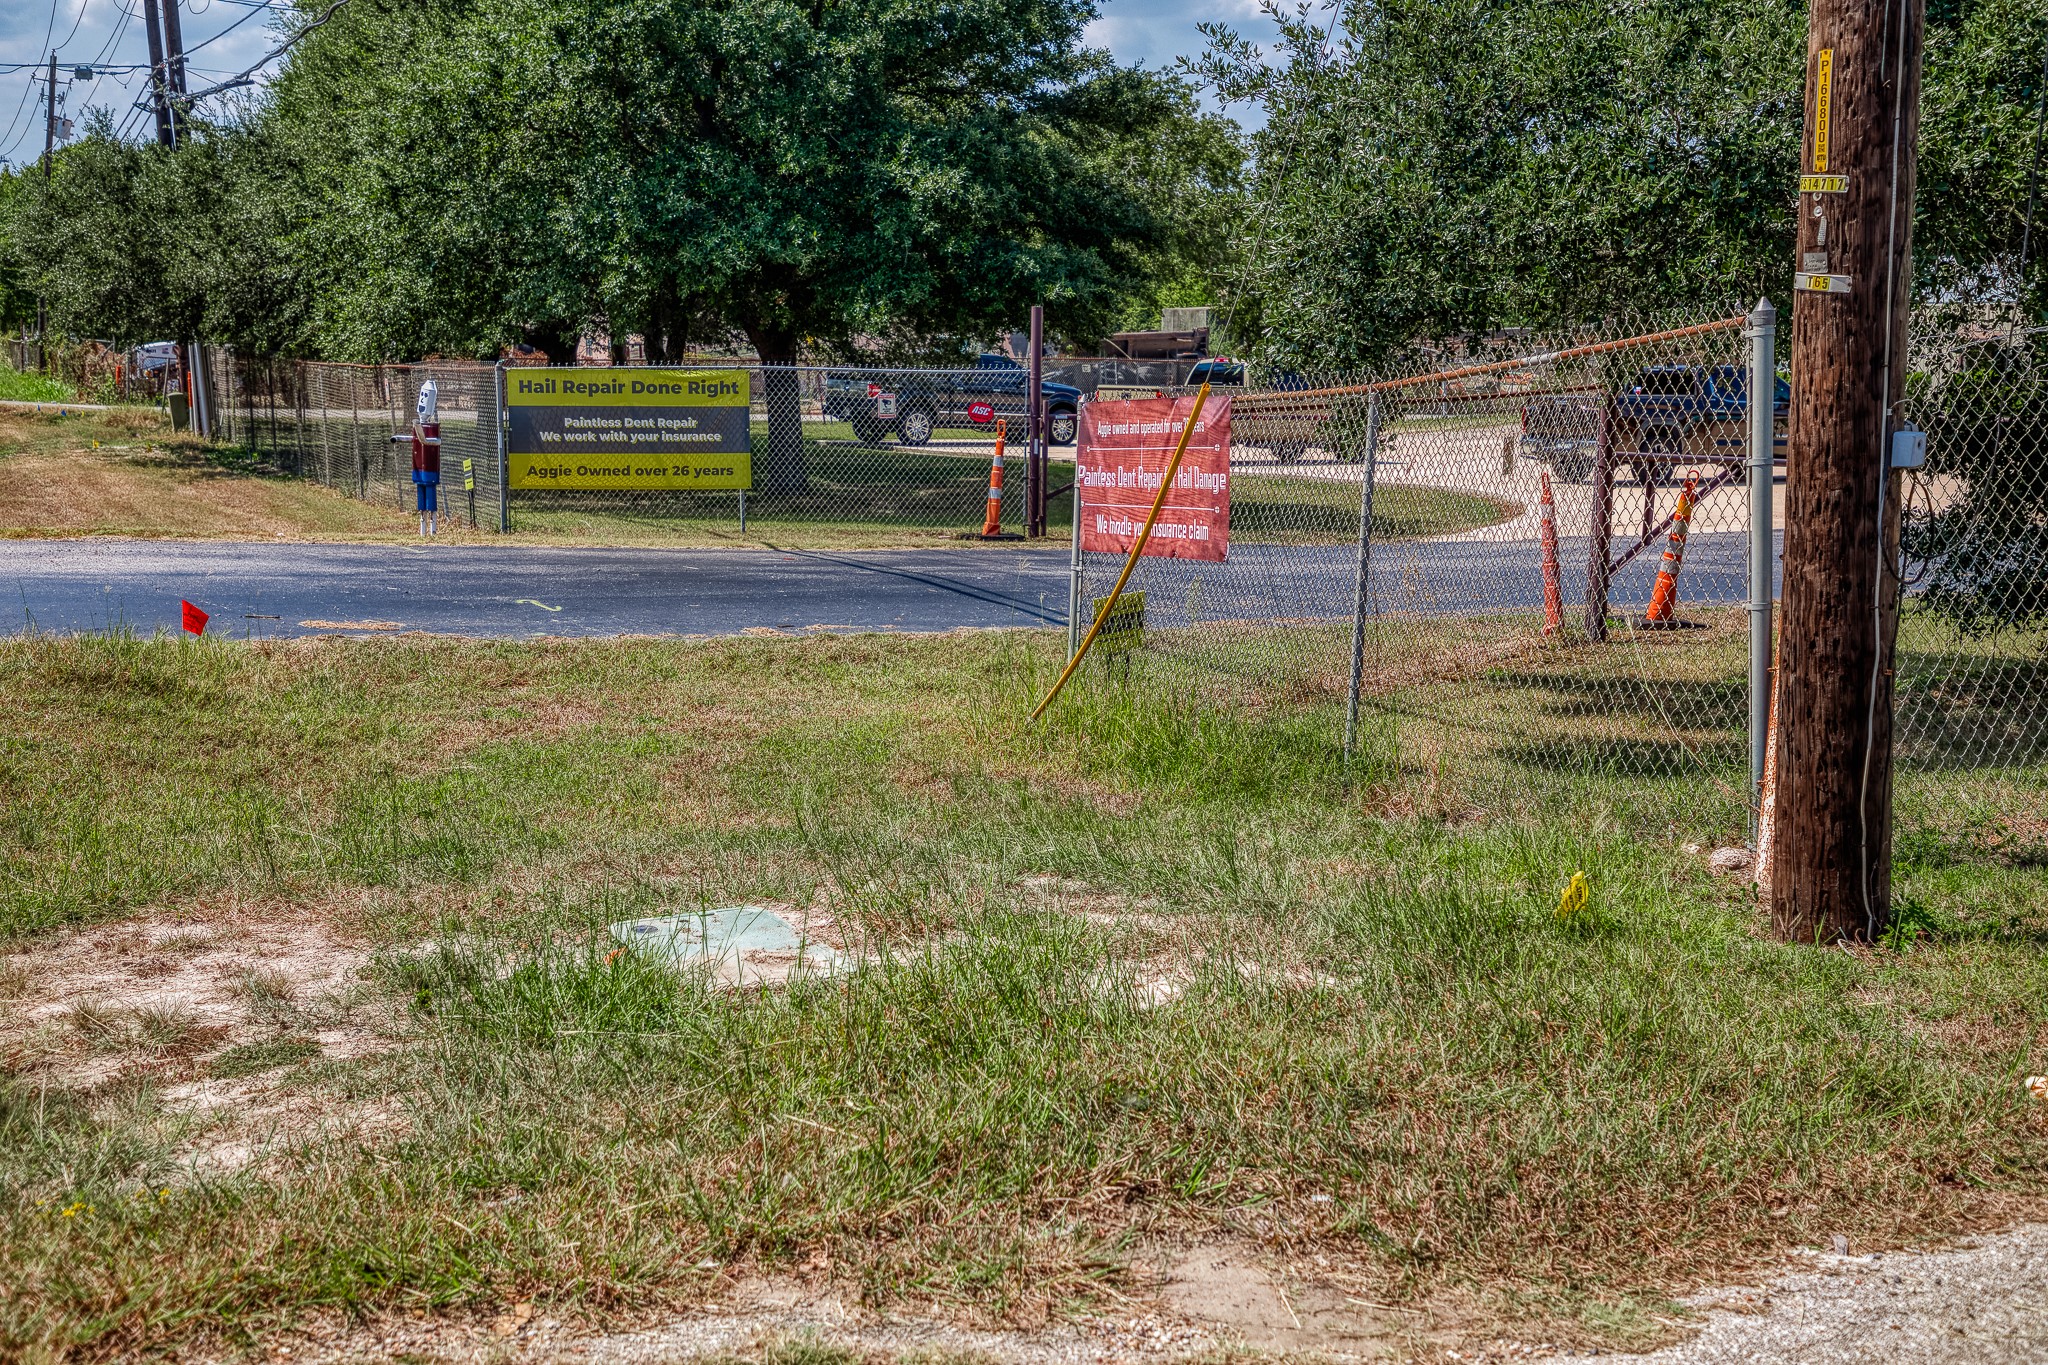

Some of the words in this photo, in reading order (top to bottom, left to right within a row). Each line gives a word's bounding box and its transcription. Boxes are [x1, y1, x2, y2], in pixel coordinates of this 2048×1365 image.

[1818, 60, 1829, 143] P166800
[519, 378, 557, 394] Hail
[563, 379, 625, 397] Repair
[632, 380, 682, 395] Done
[688, 380, 739, 398] Right
[971, 406, 991, 416] ASC
[564, 417, 622, 429] Paintless
[624, 417, 655, 429] Dent
[657, 417, 698, 431] Repair
[1097, 421, 1111, 437] Aggie
[1112, 420, 1128, 435] owned
[1130, 420, 1139, 434] and
[1141, 419, 1163, 436] operated
[1172, 421, 1183, 433] over
[540, 431, 561, 442] We
[564, 431, 597, 442] work
[600, 431, 628, 442] with
[630, 433, 660, 444] your
[662, 431, 722, 442] insurance
[527, 465, 572, 479] Aggie
[576, 465, 630, 477] Owned
[635, 467, 668, 477] over
[672, 465, 689, 477] 26
[694, 465, 734, 480] years
[1079, 465, 1115, 487] Paintless
[1118, 466, 1136, 487] Dent
[1138, 466, 1164, 492] Repair
[1178, 466, 1192, 488] Hail
[1195, 466, 1227, 494] Damage
[1096, 514, 1107, 534] We
[1188, 518, 1208, 540] claim
